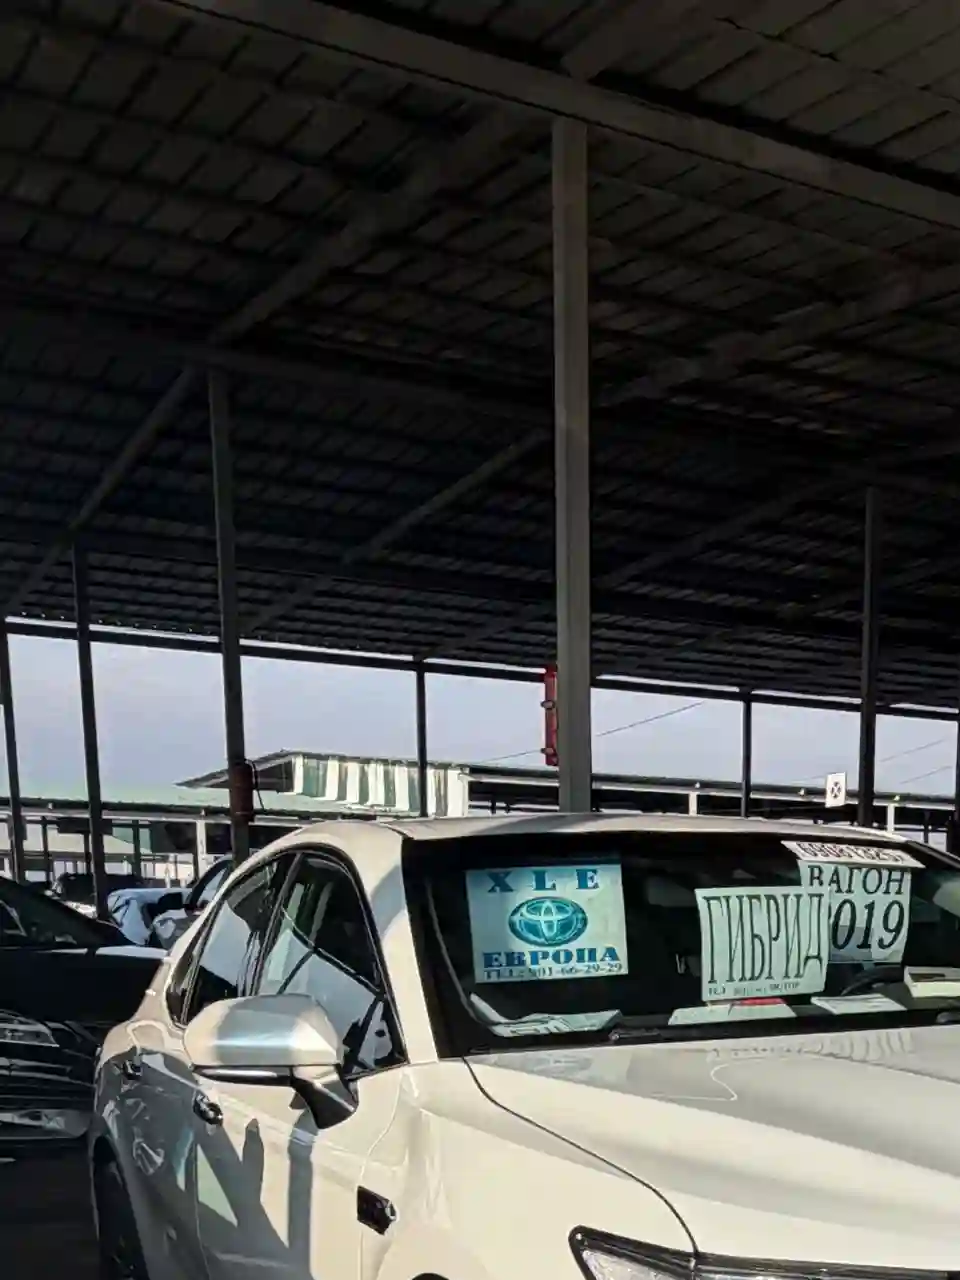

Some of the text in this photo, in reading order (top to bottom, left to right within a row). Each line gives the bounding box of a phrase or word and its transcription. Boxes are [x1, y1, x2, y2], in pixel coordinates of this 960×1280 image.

[702, 893, 825, 984] ГИБРИД
[828, 898, 905, 950] 019
[482, 947, 621, 969] ЕВРОПА
